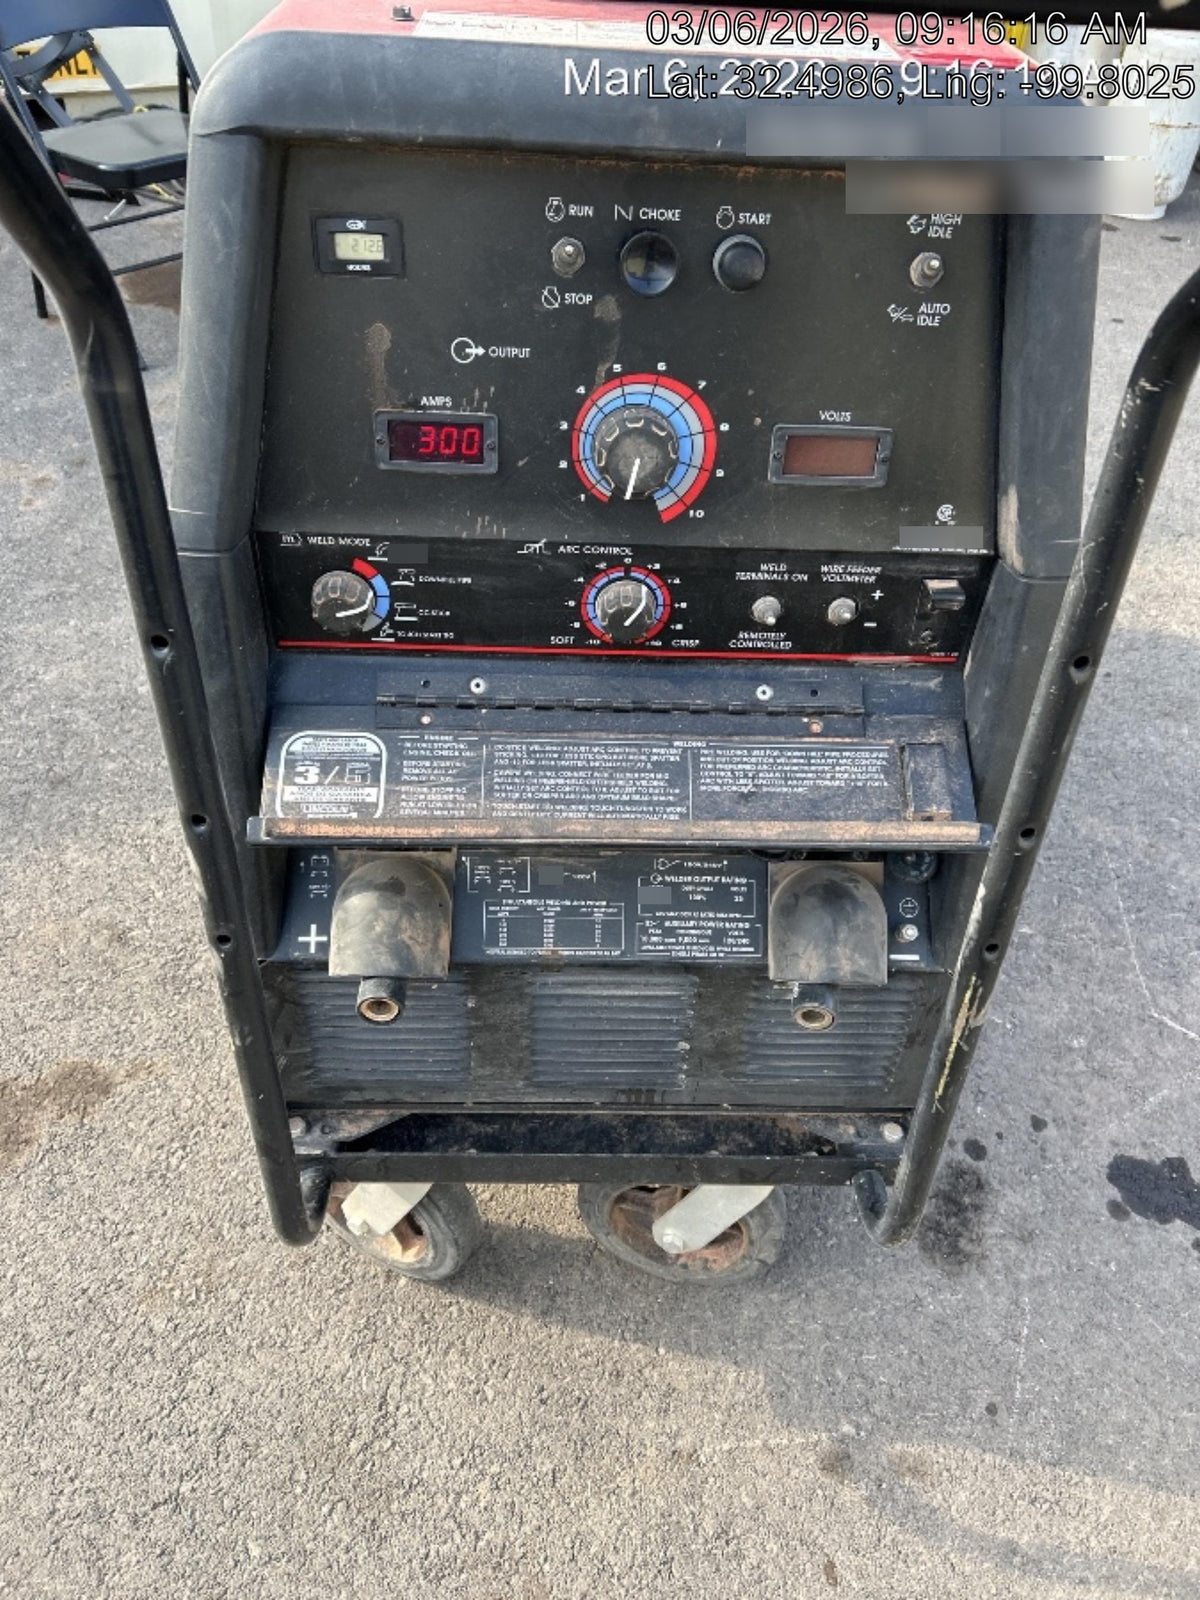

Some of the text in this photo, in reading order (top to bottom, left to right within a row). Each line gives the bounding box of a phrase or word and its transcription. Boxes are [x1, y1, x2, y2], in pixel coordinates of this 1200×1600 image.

[569, 204, 594, 217] RUN
[639, 207, 682, 221] CHOKE
[738, 212, 772, 225] START
[930, 213, 963, 225] HIGH
[928, 225, 954, 239] IDLE
[564, 293, 593, 305] STOP
[918, 302, 951, 315] AUTO
[916, 315, 942, 327] IDLE
[488, 346, 531, 358] OUTPUT
[612, 363, 623, 372] 5
[575, 385, 586, 394] 4
[698, 380, 707, 389] 7
[420, 395, 452, 407] AMPS
[818, 410, 852, 422] VOLTS
[418, 425, 480, 456] 300
[688, 509, 705, 518] 10
[307, 535, 371, 547] WELD MODE
[558, 545, 634, 555] ARC CONTROL
[760, 562, 787, 572] WELD
[550, 636, 575, 644] SOFT
